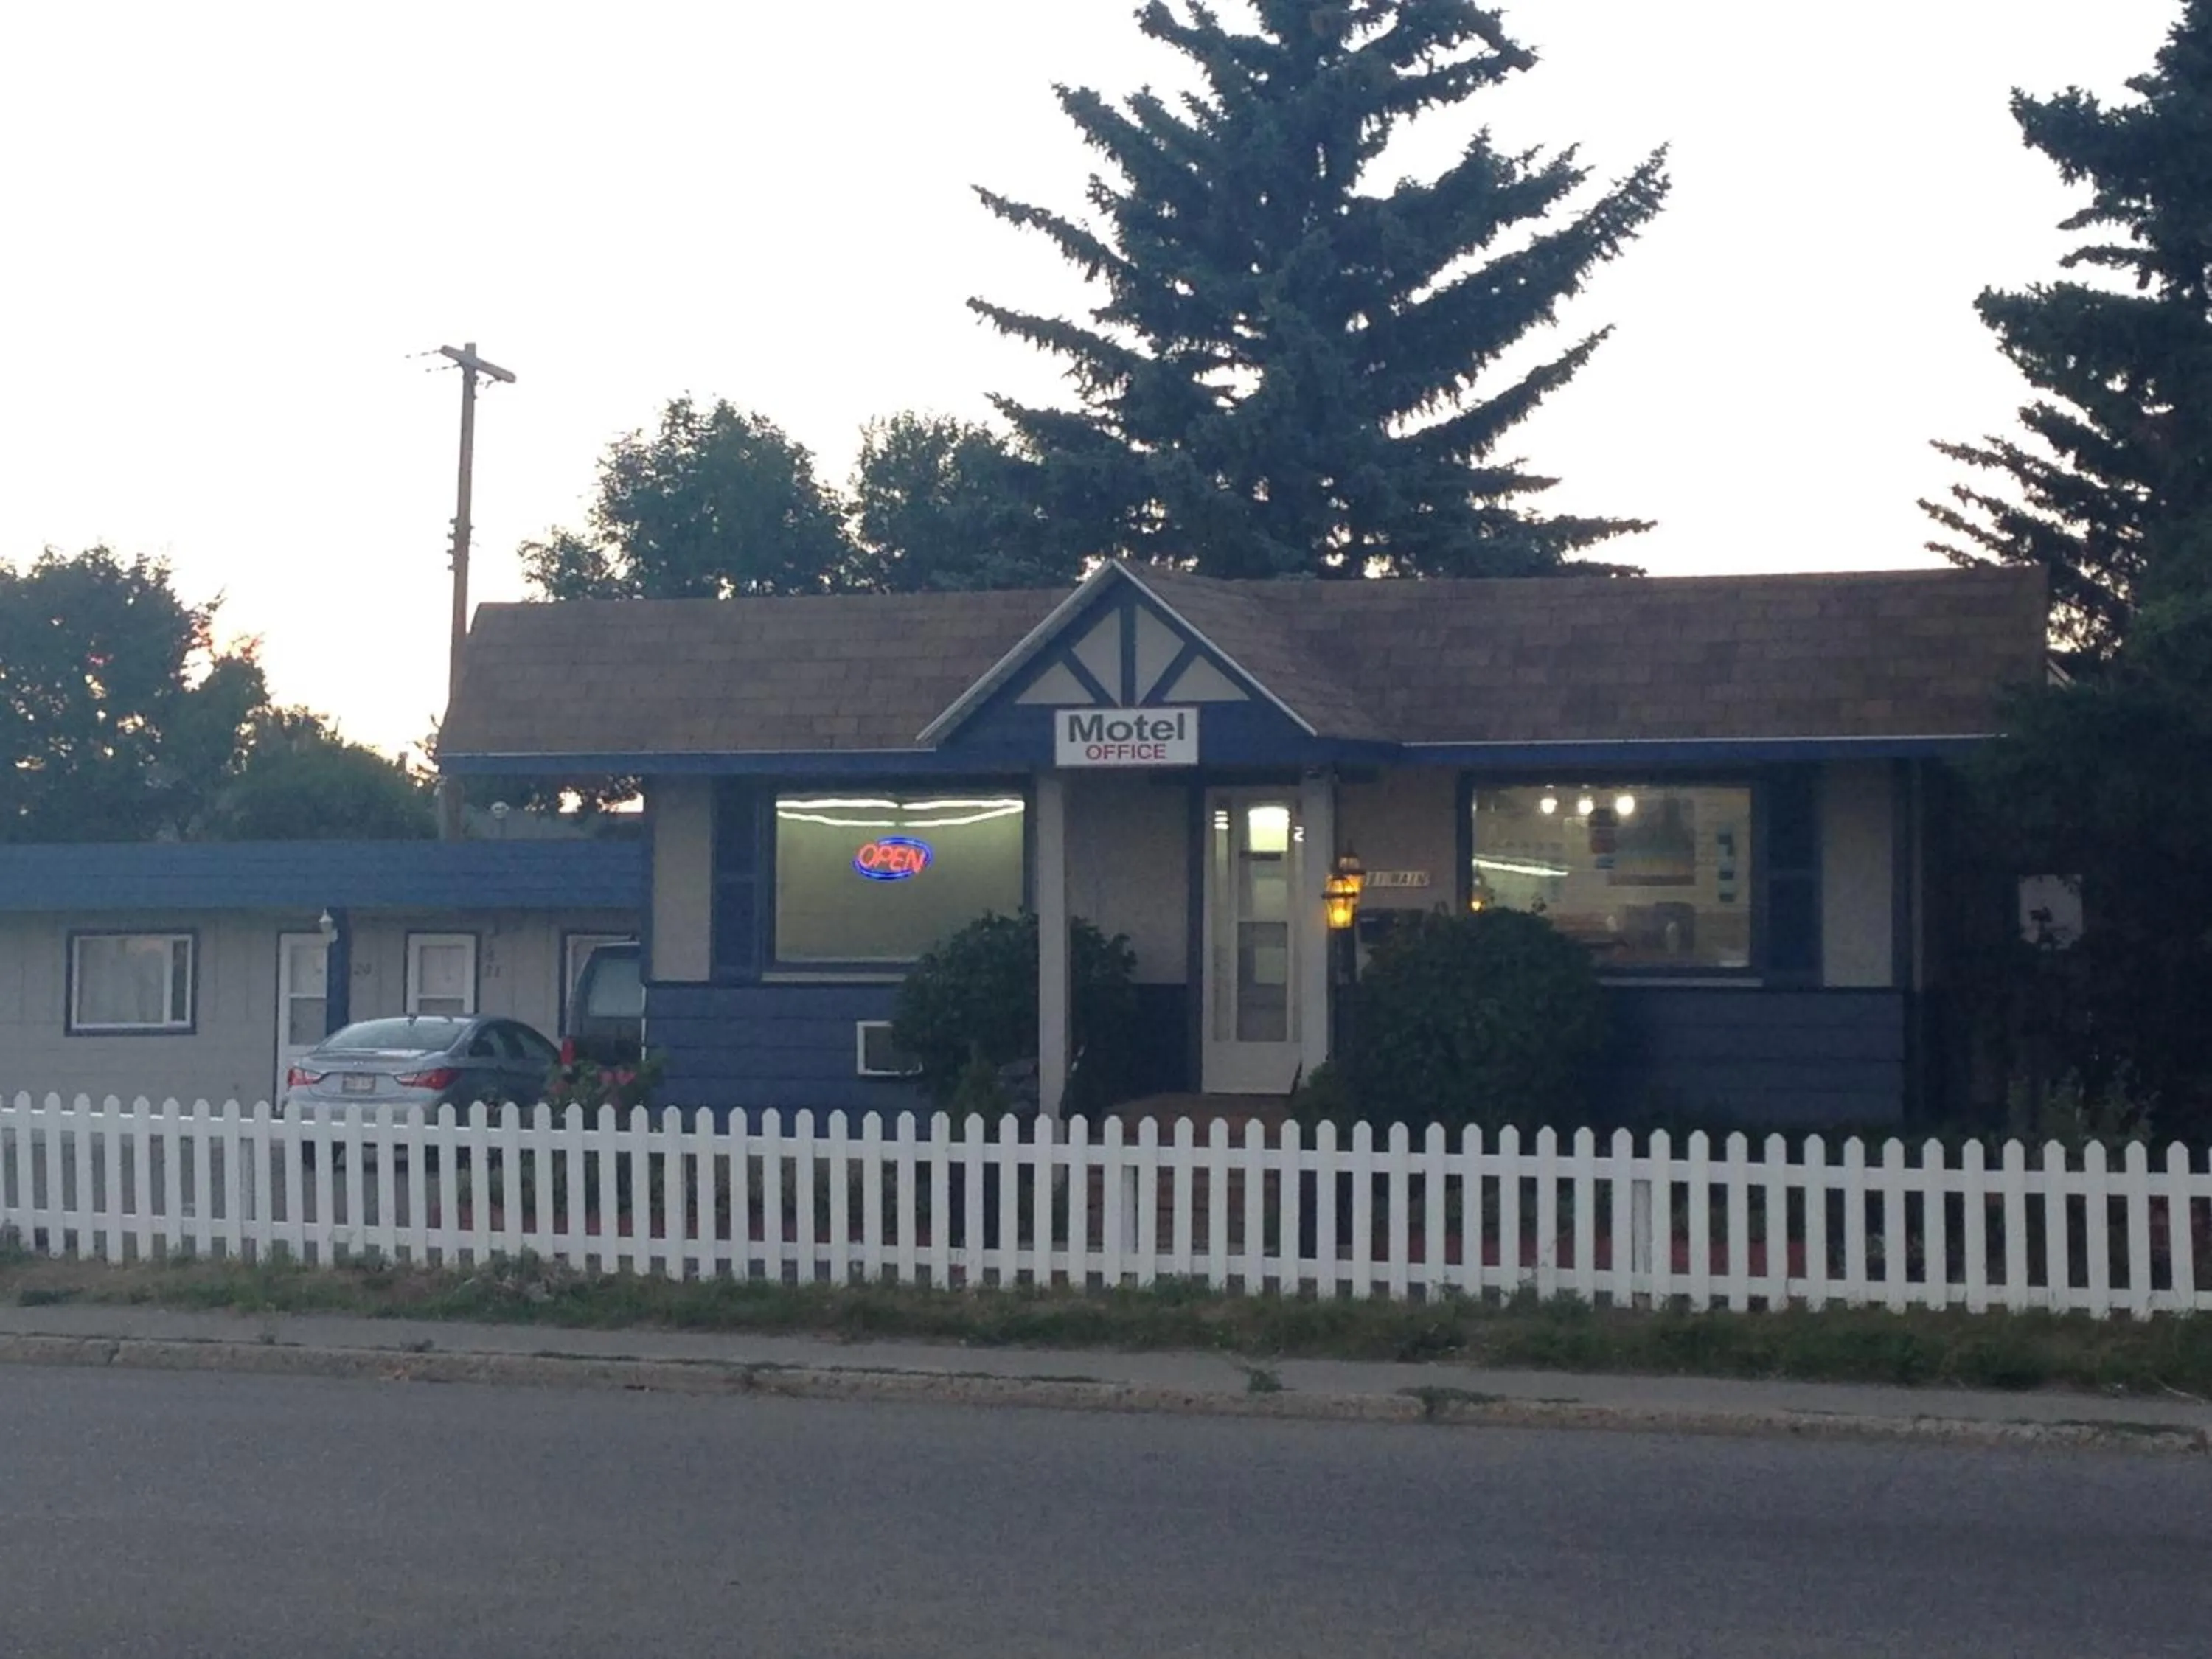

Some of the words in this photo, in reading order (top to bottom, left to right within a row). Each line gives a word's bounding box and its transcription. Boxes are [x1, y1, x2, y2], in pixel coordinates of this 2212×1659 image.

[1069, 713, 1184, 742] Motel
[1086, 744, 1166, 760] OFFICE
[858, 843, 925, 874] OPEN
